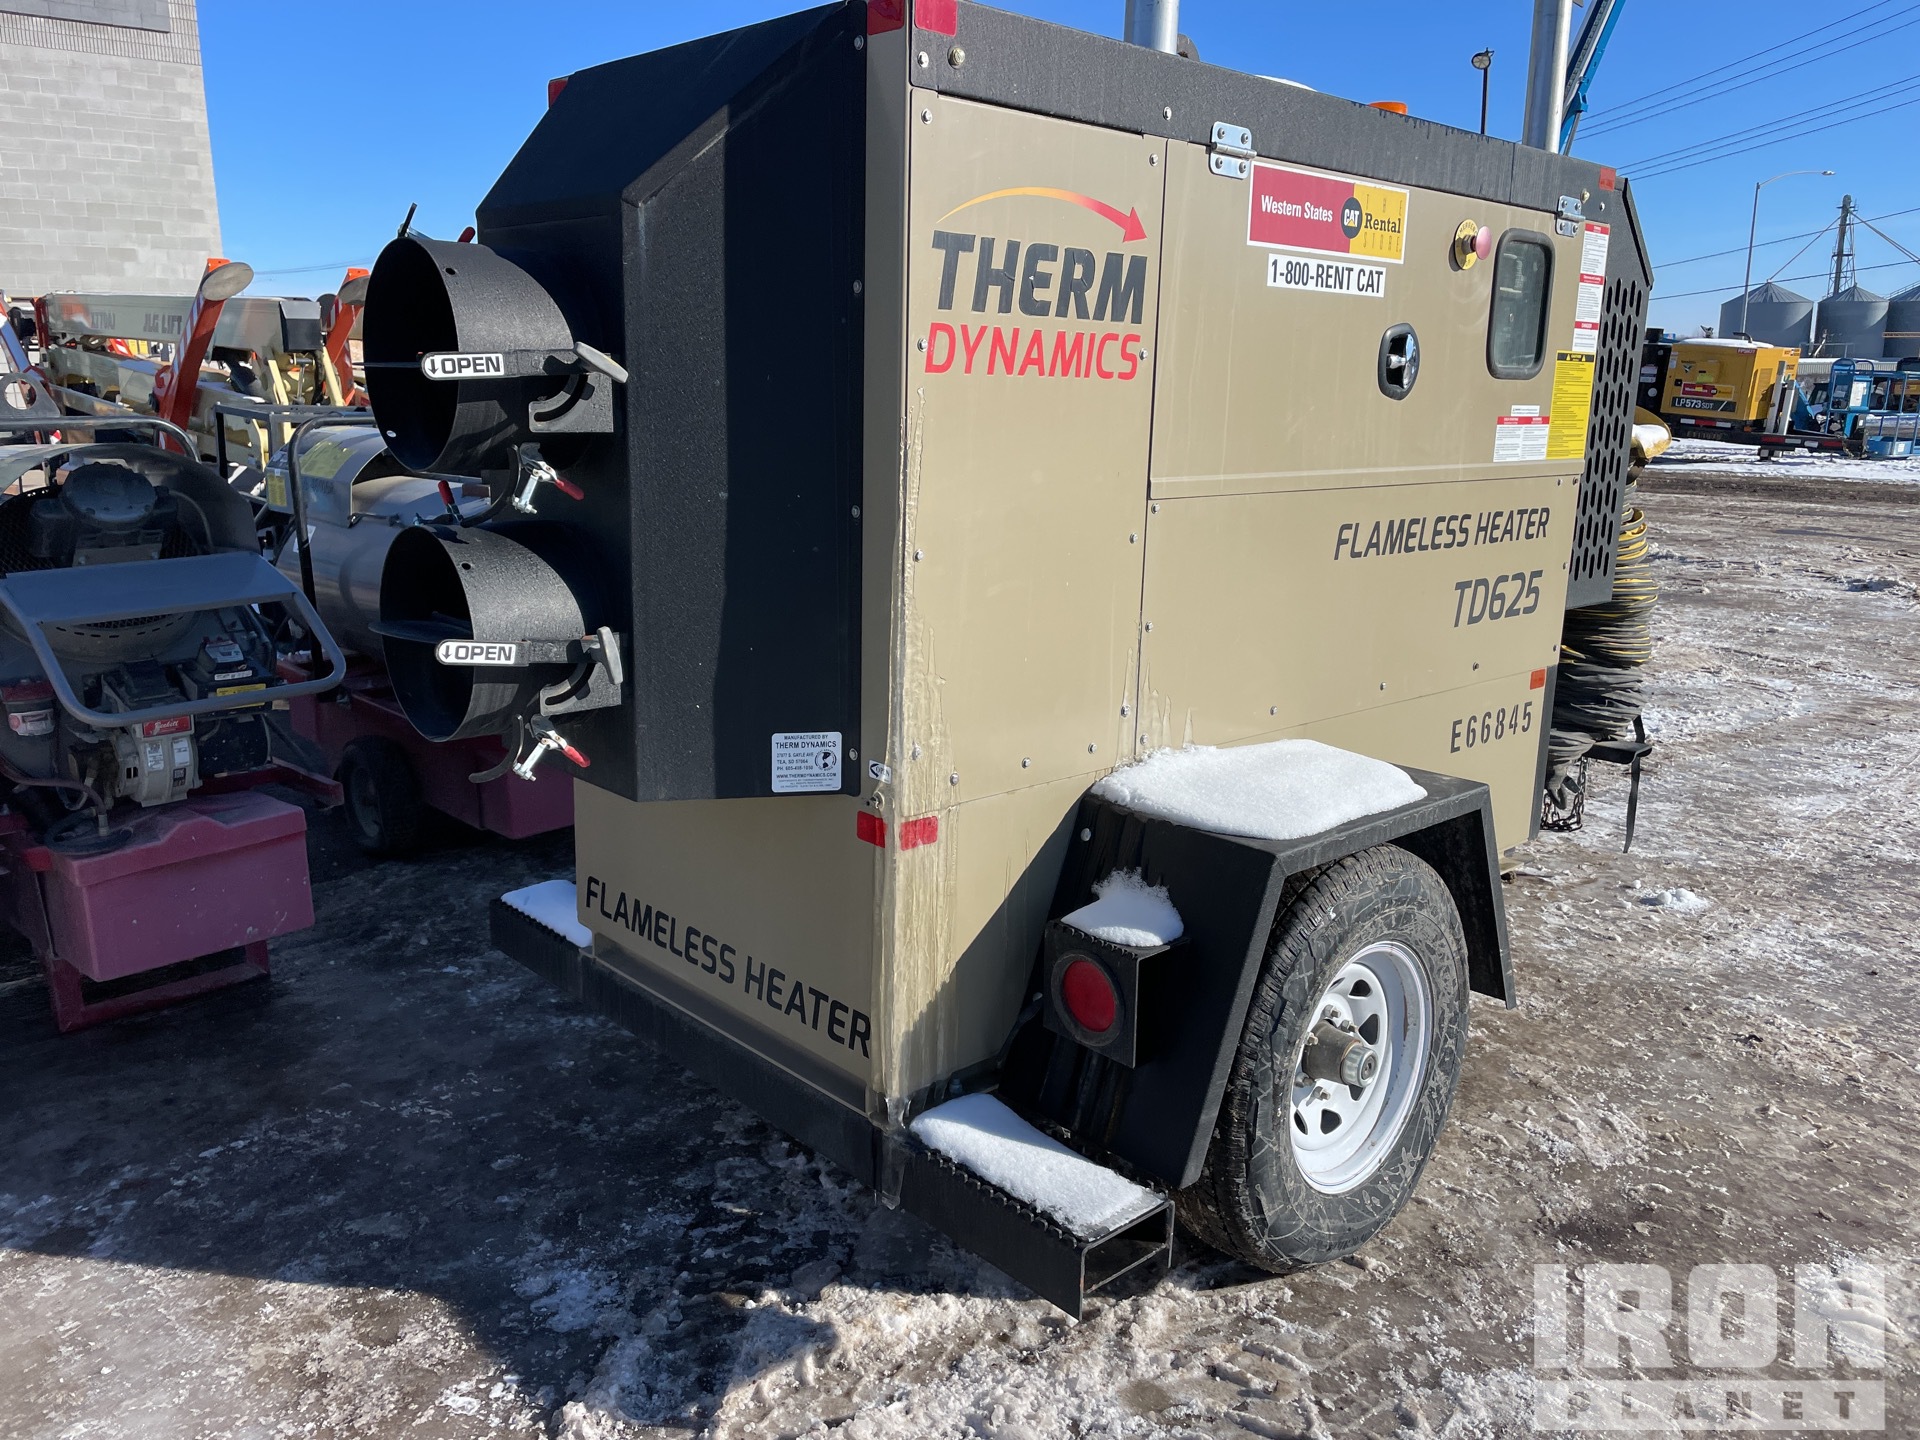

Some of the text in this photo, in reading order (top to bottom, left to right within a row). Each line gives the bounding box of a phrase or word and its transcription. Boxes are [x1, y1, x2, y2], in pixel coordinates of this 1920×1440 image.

[1261, 194, 1333, 223] Western States
[1343, 208, 1360, 228] CAT
[1364, 212, 1401, 234] Rental
[932, 230, 1148, 325] THERM
[1271, 258, 1383, 294] 1-800-RENT CAT
[440, 355, 501, 375] OPEN
[924, 322, 1141, 381] DYNAMICS
[1333, 507, 1550, 561] FLAMELESS HEATER
[1453, 569, 1544, 628] TD625
[454, 643, 513, 662] OPEN
[775, 740, 837, 749] THERM DYNAMICS
[1450, 701, 1533, 754] E66845
[585, 875, 871, 1059] FLAMELESS HEATER
